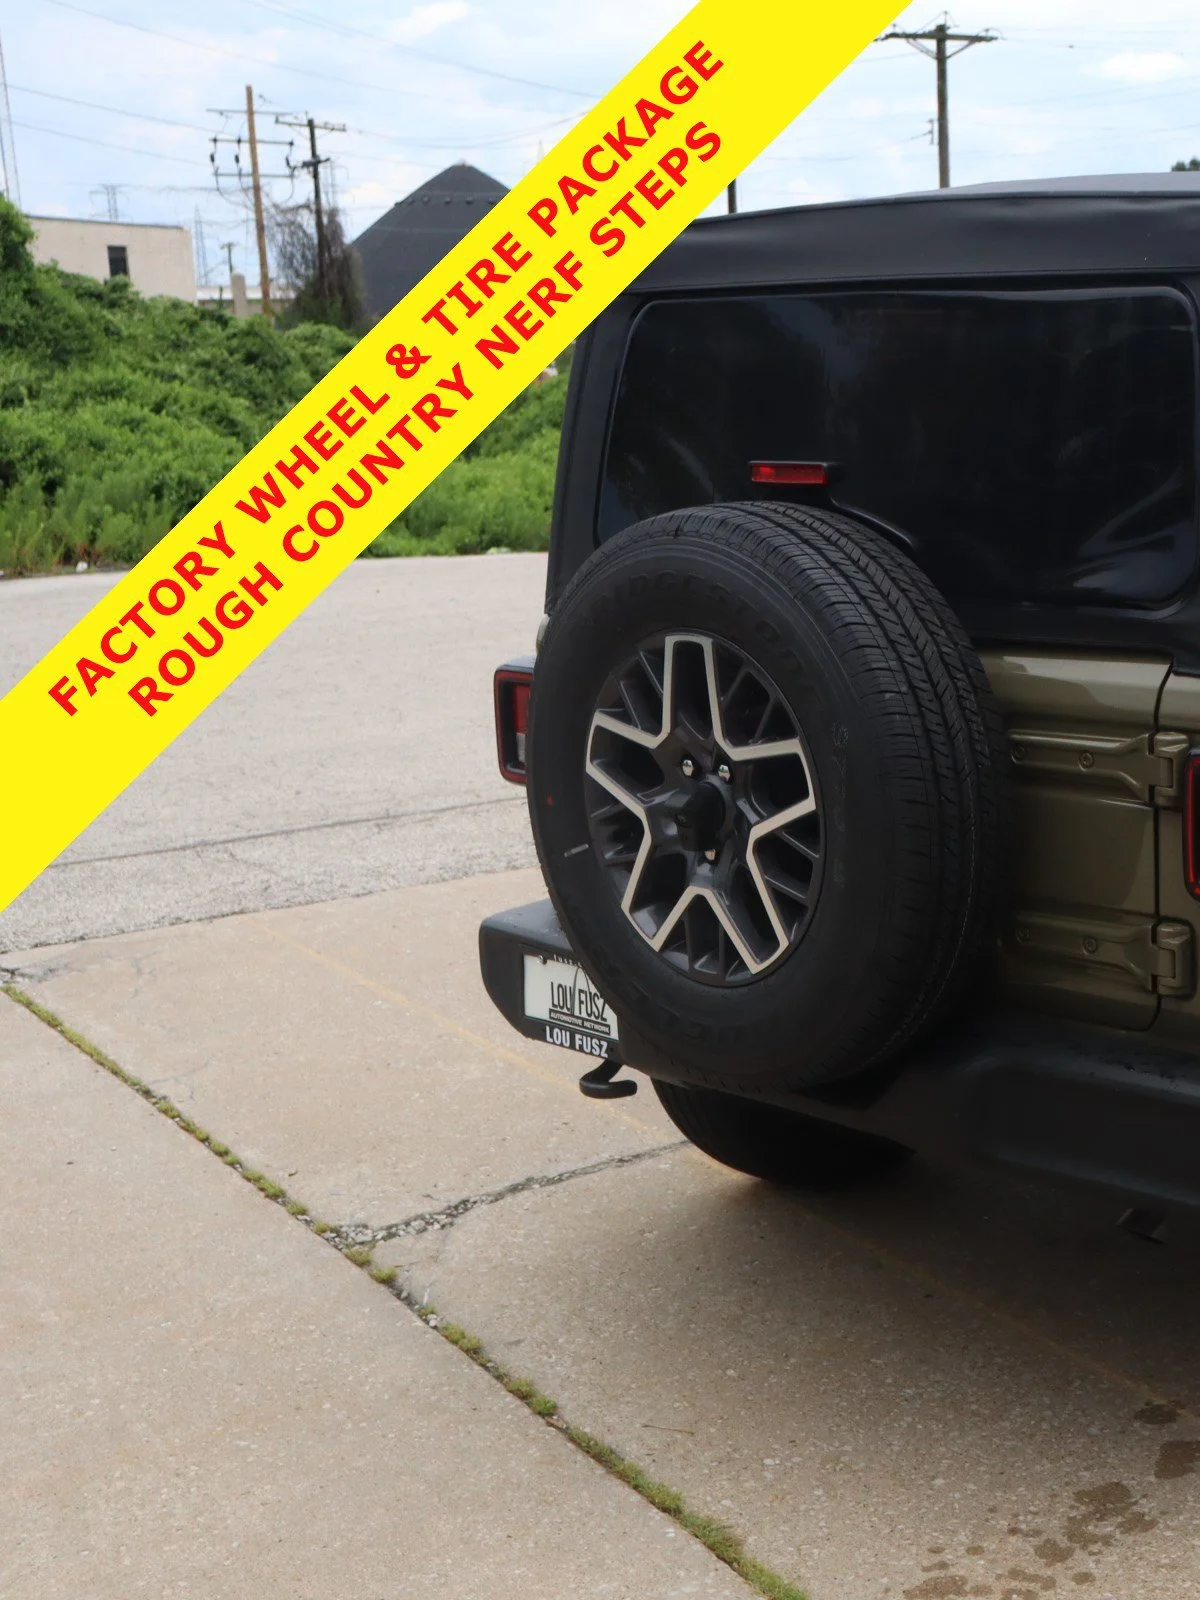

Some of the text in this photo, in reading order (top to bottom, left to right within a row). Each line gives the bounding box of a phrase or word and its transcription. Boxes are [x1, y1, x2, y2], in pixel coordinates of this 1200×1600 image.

[551, 981, 608, 1022] LOU FUSZ
[550, 1012, 610, 1034] AUTOMOTIVE NETWORK
[545, 1025, 609, 1058] LOU FUSZ
